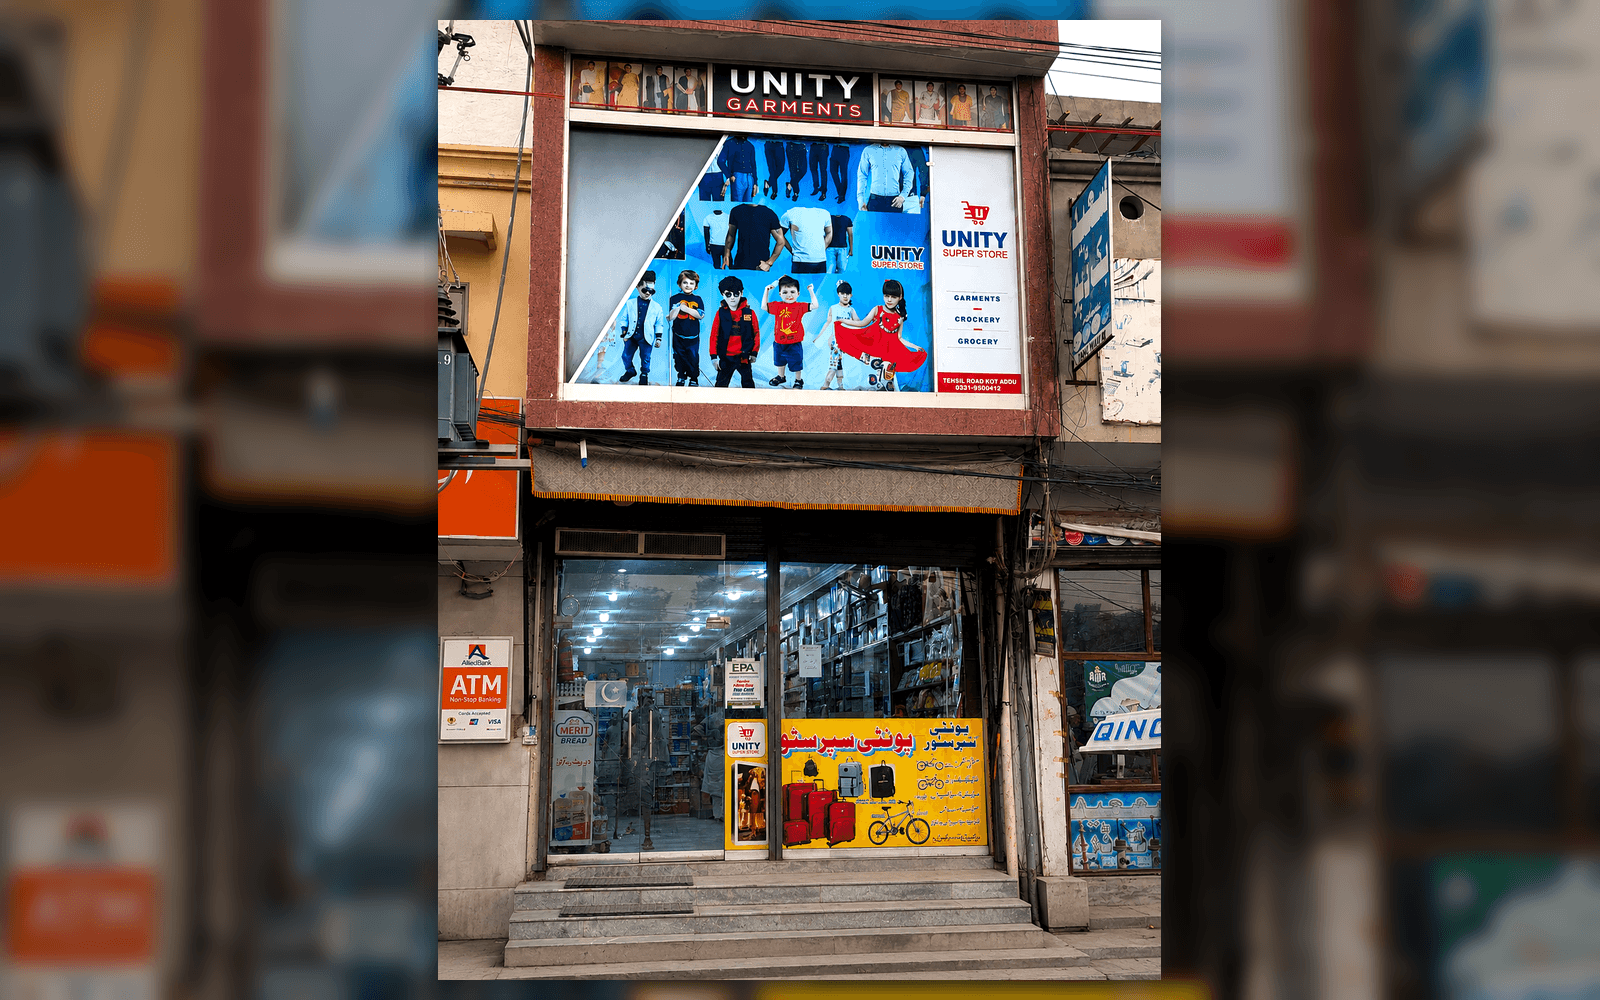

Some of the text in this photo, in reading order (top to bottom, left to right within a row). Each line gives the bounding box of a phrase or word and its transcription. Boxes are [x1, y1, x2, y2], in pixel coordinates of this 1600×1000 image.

[730, 69, 860, 99] UNITY
[726, 97, 862, 118] GARMENTS
[941, 229, 1008, 249] UNITY
[871, 245, 924, 261] UNITY
[942, 249, 1008, 259] SUPER STORE
[871, 261, 924, 270] SUPER STORE
[953, 294, 1001, 302] GARMENTS
[954, 315, 1001, 323] CROCKERY
[957, 337, 999, 345] GROCERY
[732, 663, 754, 672] EPA
[450, 674, 502, 695] ATM
[560, 726, 590, 735] MERIT
[732, 742, 760, 750] UNITY
